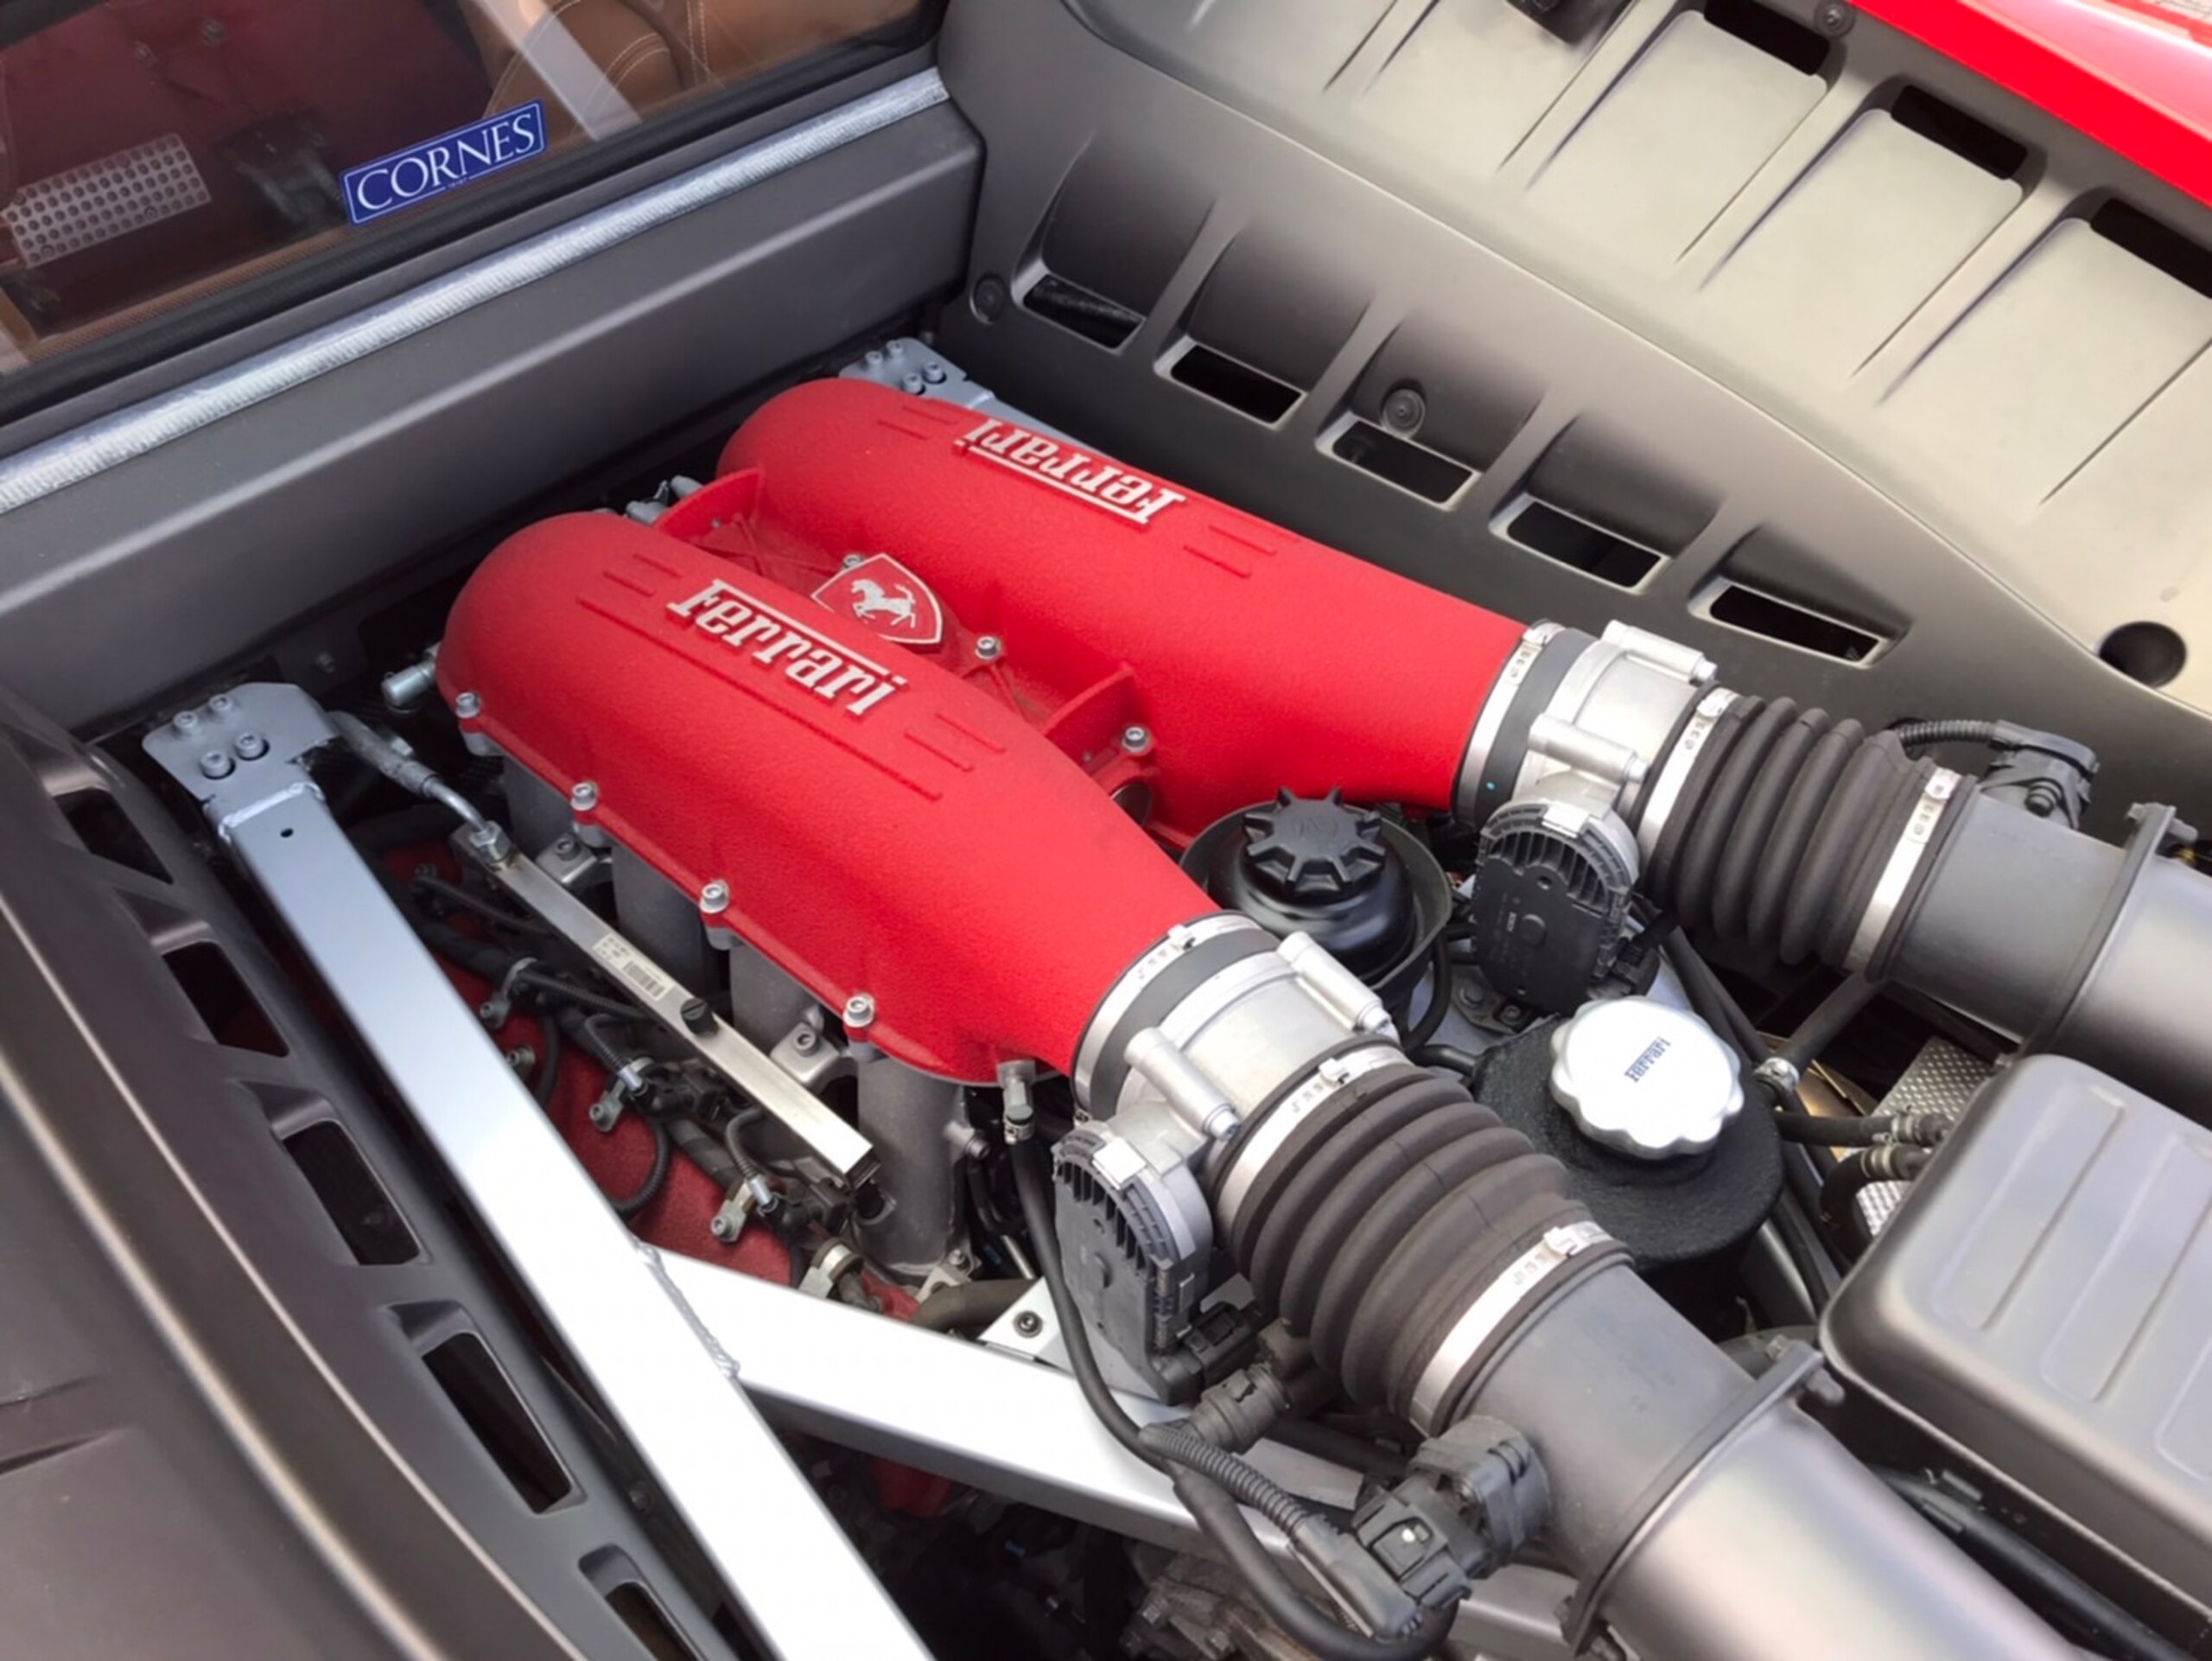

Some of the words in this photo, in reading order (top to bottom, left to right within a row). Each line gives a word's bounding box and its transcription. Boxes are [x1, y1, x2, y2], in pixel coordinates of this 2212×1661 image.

[357, 113, 535, 210] CORNES
[954, 418, 1186, 525] Ferrari
[666, 577, 908, 716] Ferrari
[1624, 1036, 1672, 1083] Ferrari
